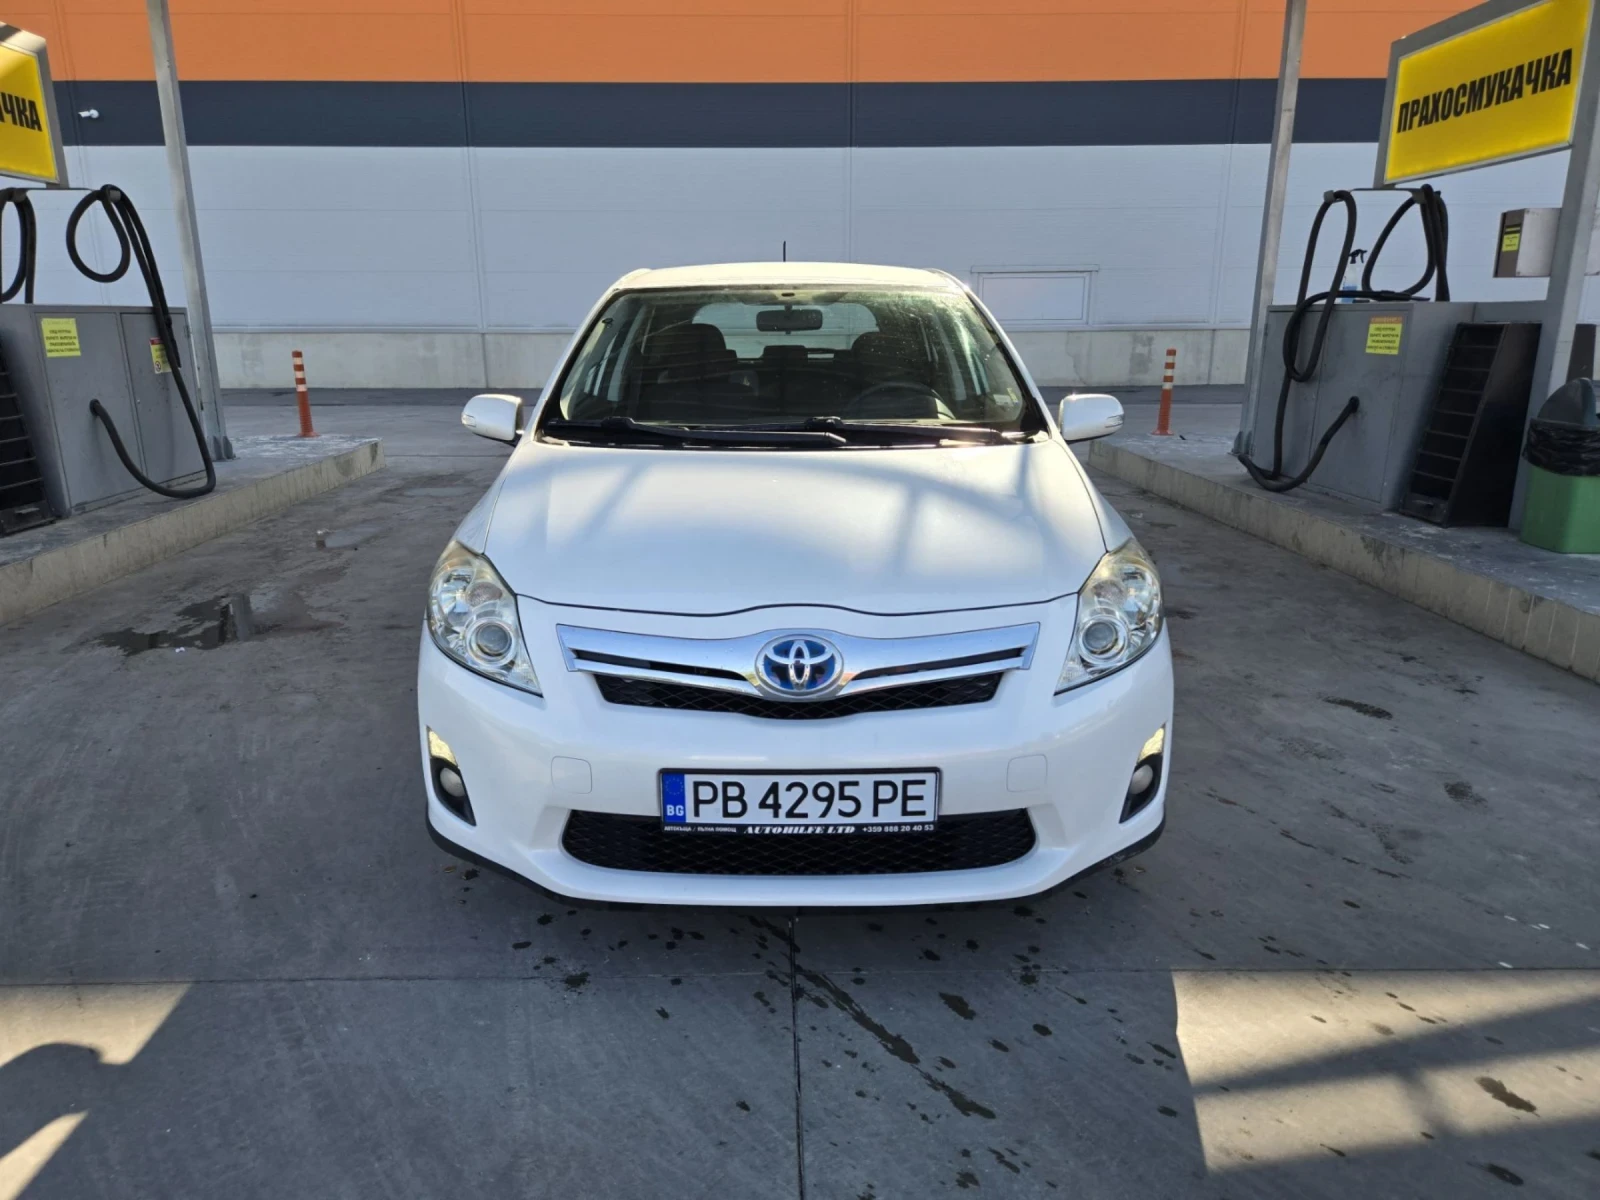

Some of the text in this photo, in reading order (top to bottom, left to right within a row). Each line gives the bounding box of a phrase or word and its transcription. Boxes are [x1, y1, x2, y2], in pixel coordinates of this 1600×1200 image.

[1397, 48, 1572, 133] ПРАХОСМУКАЧКА
[693, 779, 927, 818] PB 4295 PE
[666, 804, 685, 816] BG
[743, 825, 856, 835] AUTOHILFE LTD
[862, 825, 882, 833] +359
